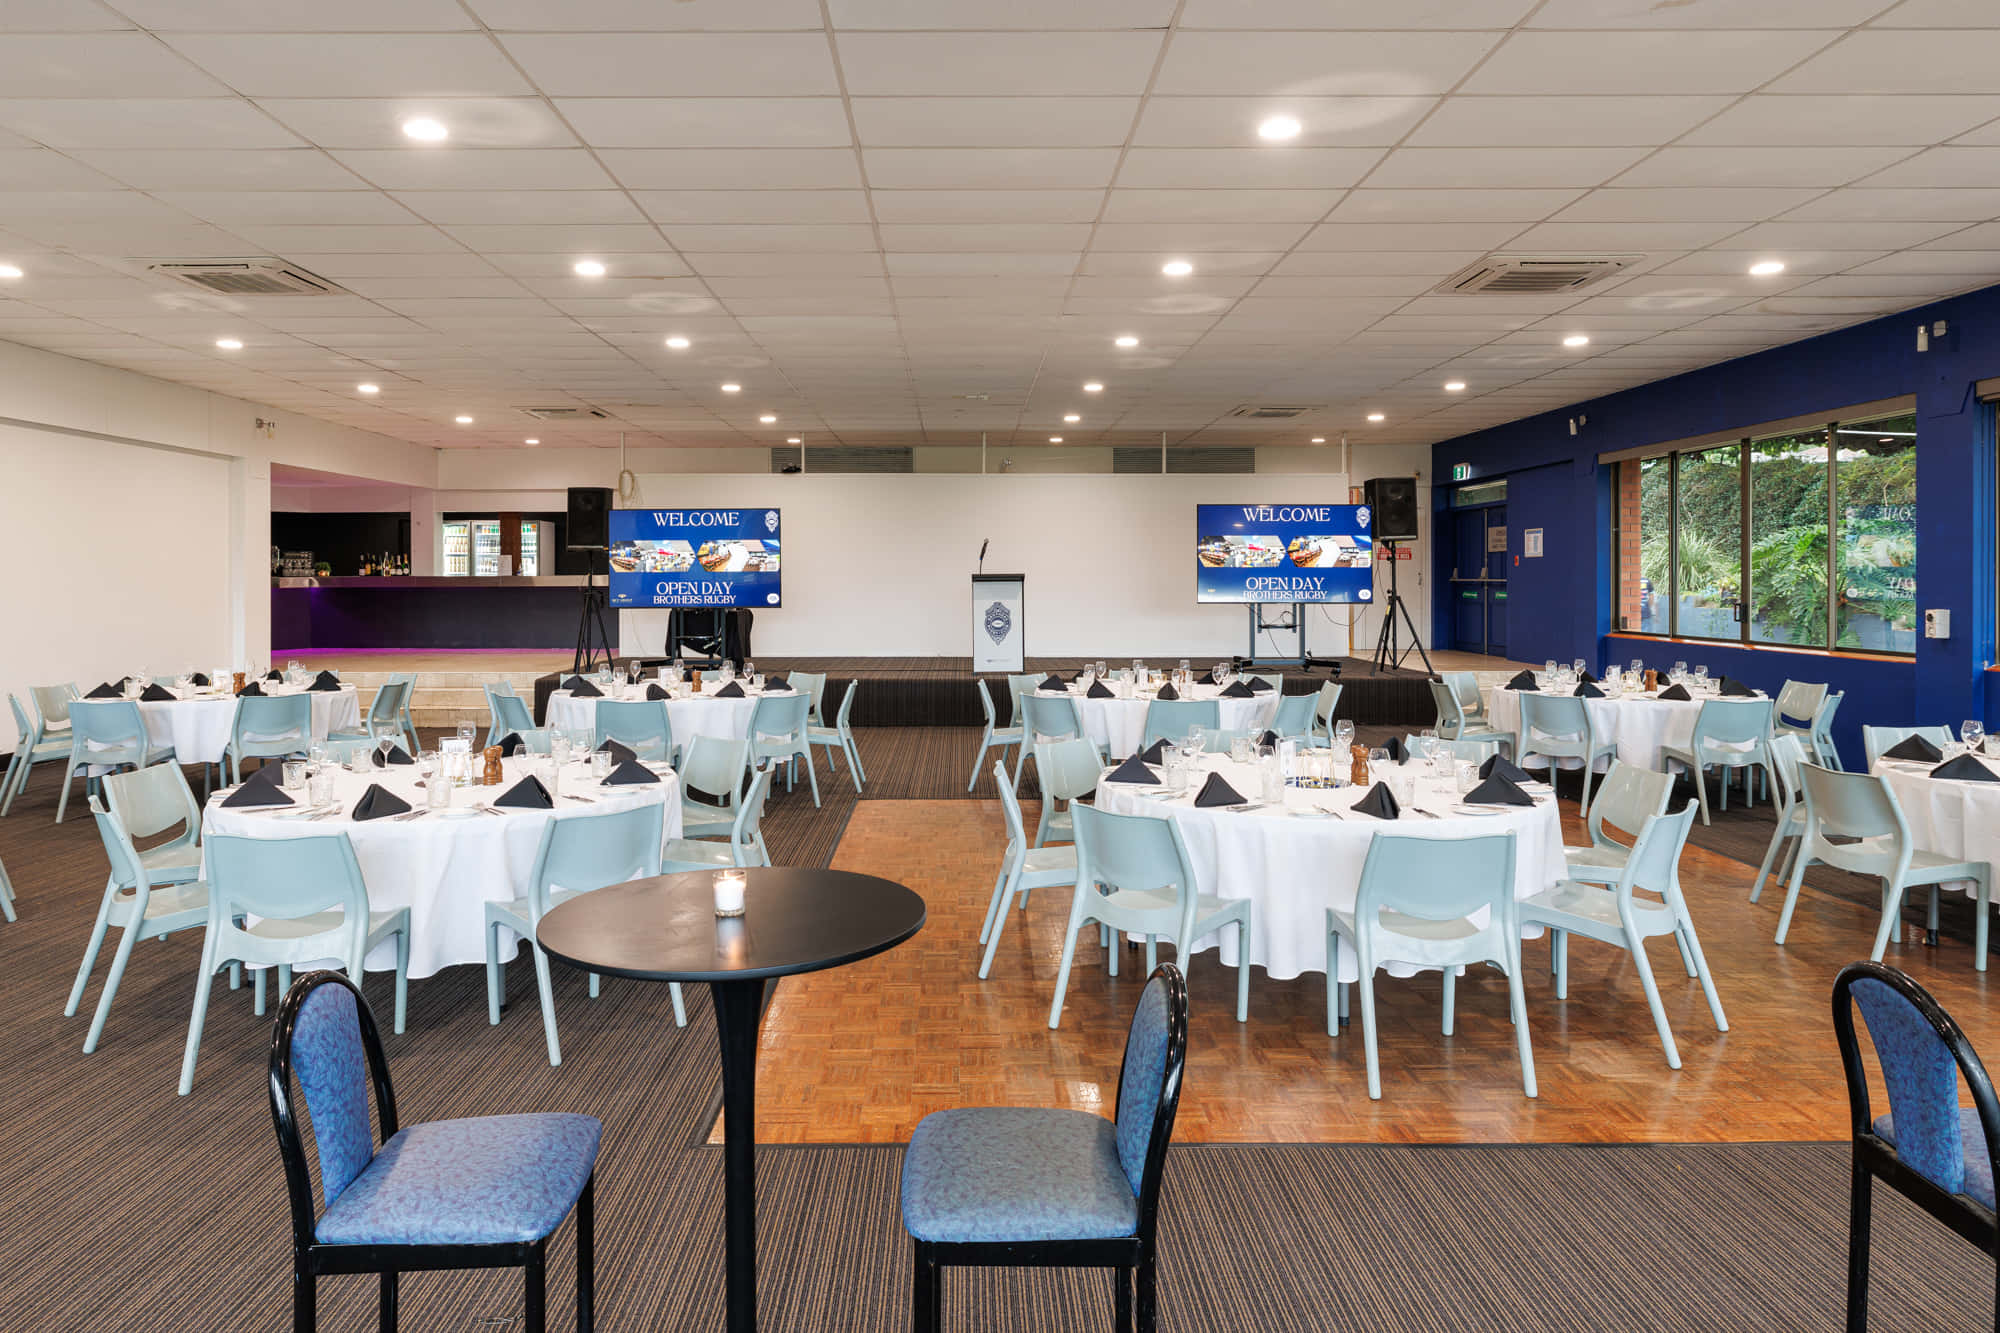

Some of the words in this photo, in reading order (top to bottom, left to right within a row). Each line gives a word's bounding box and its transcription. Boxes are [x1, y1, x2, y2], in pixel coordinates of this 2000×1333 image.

[653, 512, 739, 527] WELCOME
[1243, 508, 1330, 522] WELCOME
[656, 581, 698, 595] OPEN
[702, 581, 733, 595] DAY
[1246, 577, 1288, 590] OPEN
[1292, 577, 1325, 590] DAY
[653, 595, 703, 605] BROTHERS
[704, 595, 736, 605] RUGBY
[1243, 591, 1293, 600] BROTHERS
[1294, 591, 1328, 600] RUGBY
